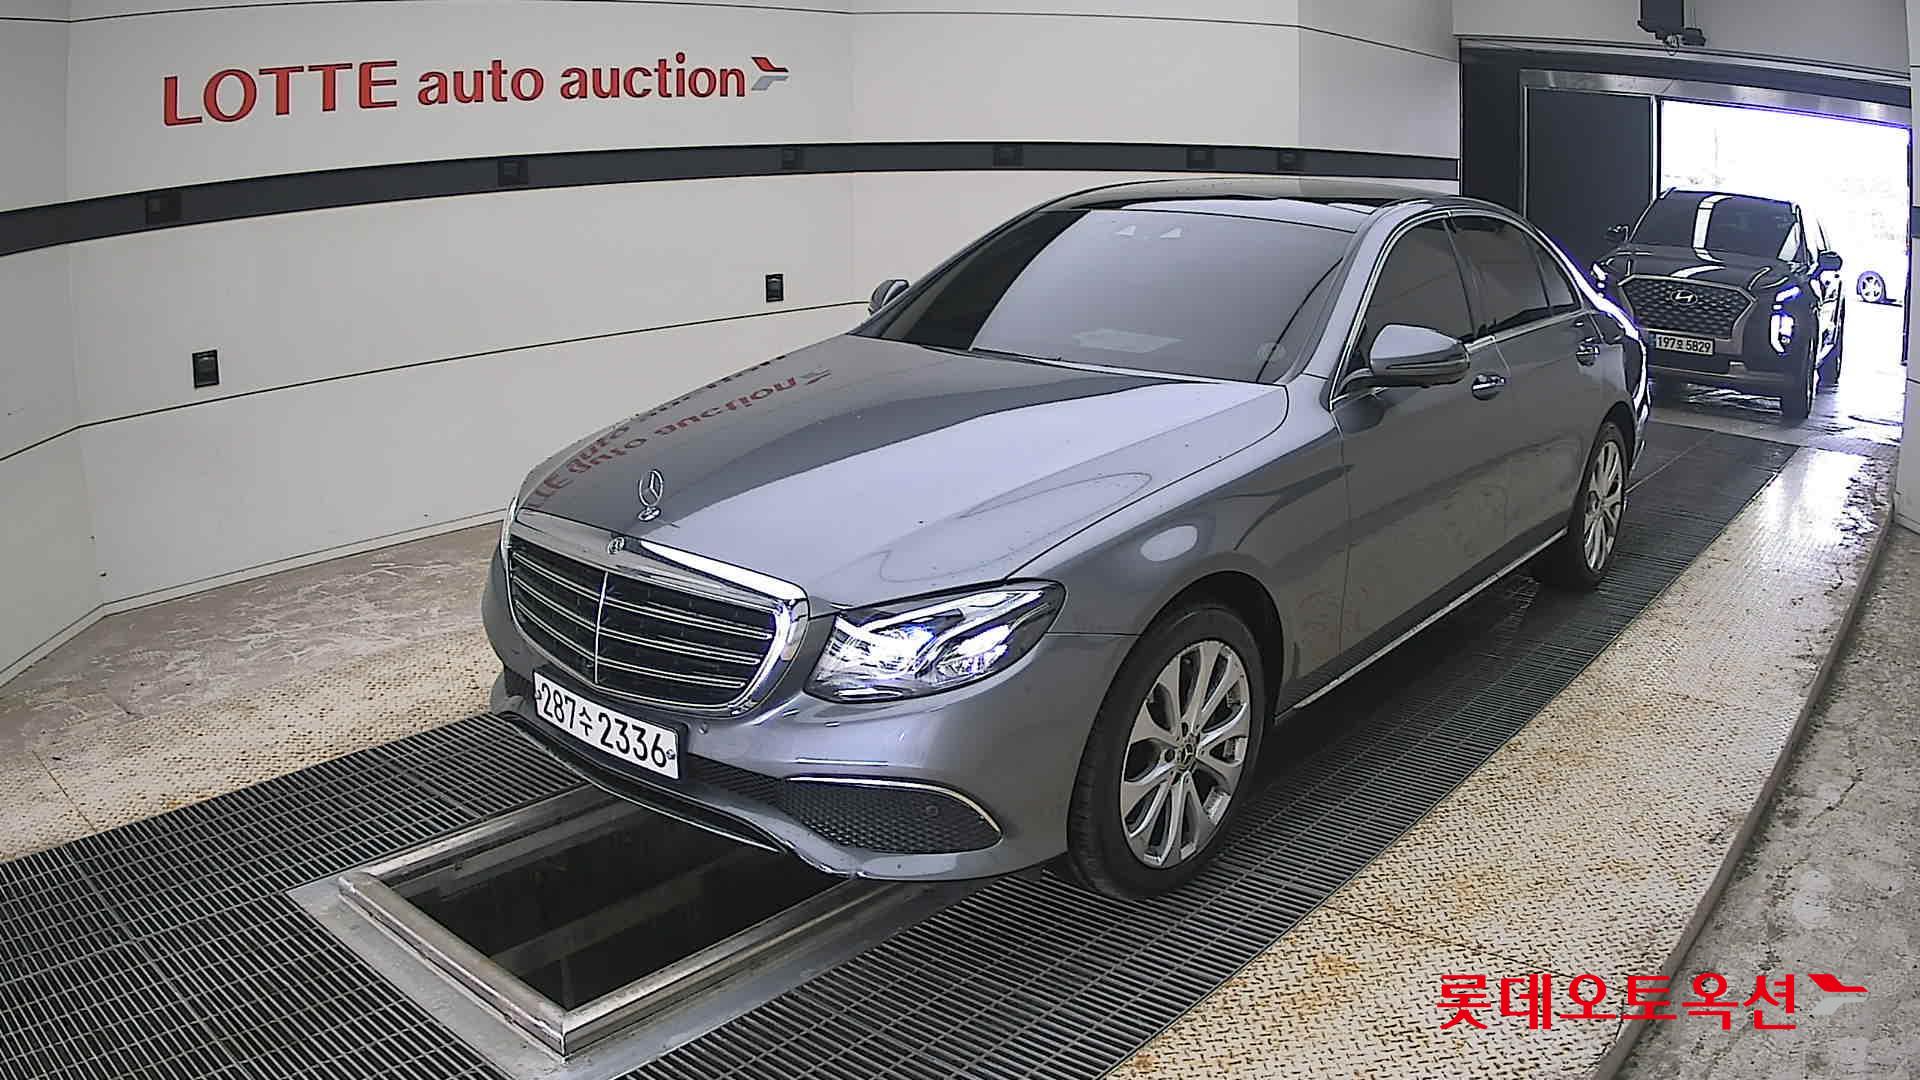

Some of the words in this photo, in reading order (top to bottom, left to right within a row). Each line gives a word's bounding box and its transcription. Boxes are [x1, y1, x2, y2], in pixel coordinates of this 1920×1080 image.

[163, 60, 398, 126] LOTTE
[417, 60, 545, 106] auto
[560, 53, 747, 100] auction
